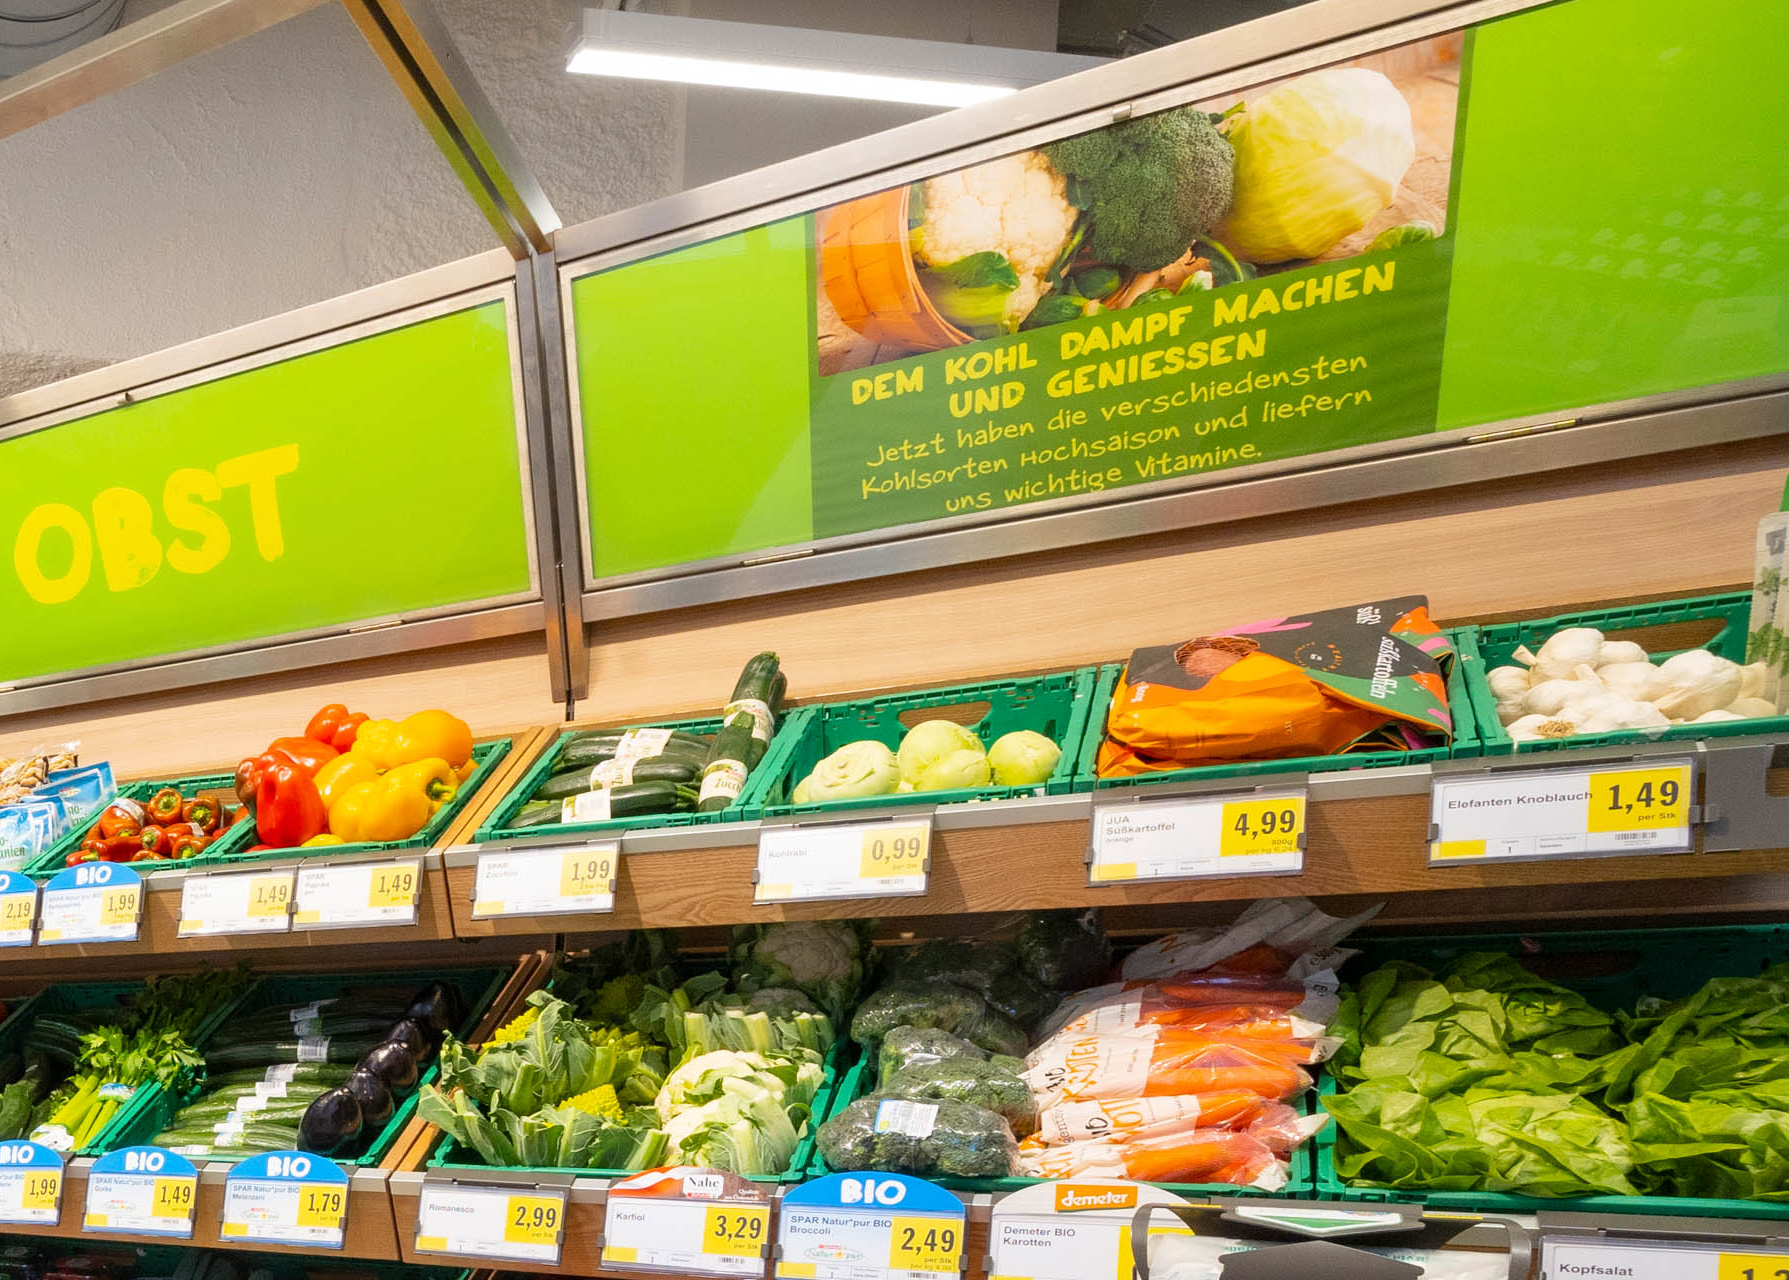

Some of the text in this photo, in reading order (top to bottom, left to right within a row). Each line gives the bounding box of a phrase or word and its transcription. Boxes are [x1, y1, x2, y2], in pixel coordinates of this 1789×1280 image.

[851, 261, 1396, 406] DEM KOHL DAMPF MACHEN
[949, 329, 1266, 418] UND GENIESSEN
[867, 353, 1368, 467] Jetzt haben die verschiedensten
[860, 387, 1372, 499] Kohlsorten Hochsaison und liefern
[946, 446, 1262, 513] uns wichtige Vitamine.
[14, 443, 299, 604] OBST
[1448, 791, 1593, 809] Elefanten Knoblauch
[1608, 780, 1679, 814] 1,49
[1107, 816, 1130, 824] JUA
[1107, 823, 1175, 835] Süßkartoffel
[1235, 810, 1295, 840] 4,99
[769, 850, 807, 858] Kohlrabi
[872, 837, 921, 864] 0,99
[76, 864, 111, 884] BIO
[572, 860, 610, 882] 1,99
[379, 874, 412, 895] 1,49
[257, 885, 287, 905] 1,49
[0, 1145, 34, 1163] BIO
[125, 1152, 164, 1171] BIO
[267, 1156, 311, 1178] BIO
[30, 1179, 56, 1197] 1,99
[689, 1177, 719, 1189] Nahe
[841, 1179, 906, 1205] BIO
[161, 1185, 190, 1204] 1,49
[308, 1193, 340, 1216] 1,79
[1061, 1190, 1128, 1207] demeter
[429, 1203, 475, 1213] Romanesco
[515, 1206, 557, 1229] 2,99
[616, 1213, 645, 1221] Karfiol
[715, 1215, 762, 1240] 3,29
[790, 1226, 831, 1235] Broccoli
[791, 1216, 892, 1228] SPAR BIO
[1004, 1226, 1075, 1236] Demeter BIO
[901, 1228, 955, 1255] 2,49
[1004, 1238, 1051, 1247] Karotten
[1559, 1264, 1633, 1276] Kopfsalat
